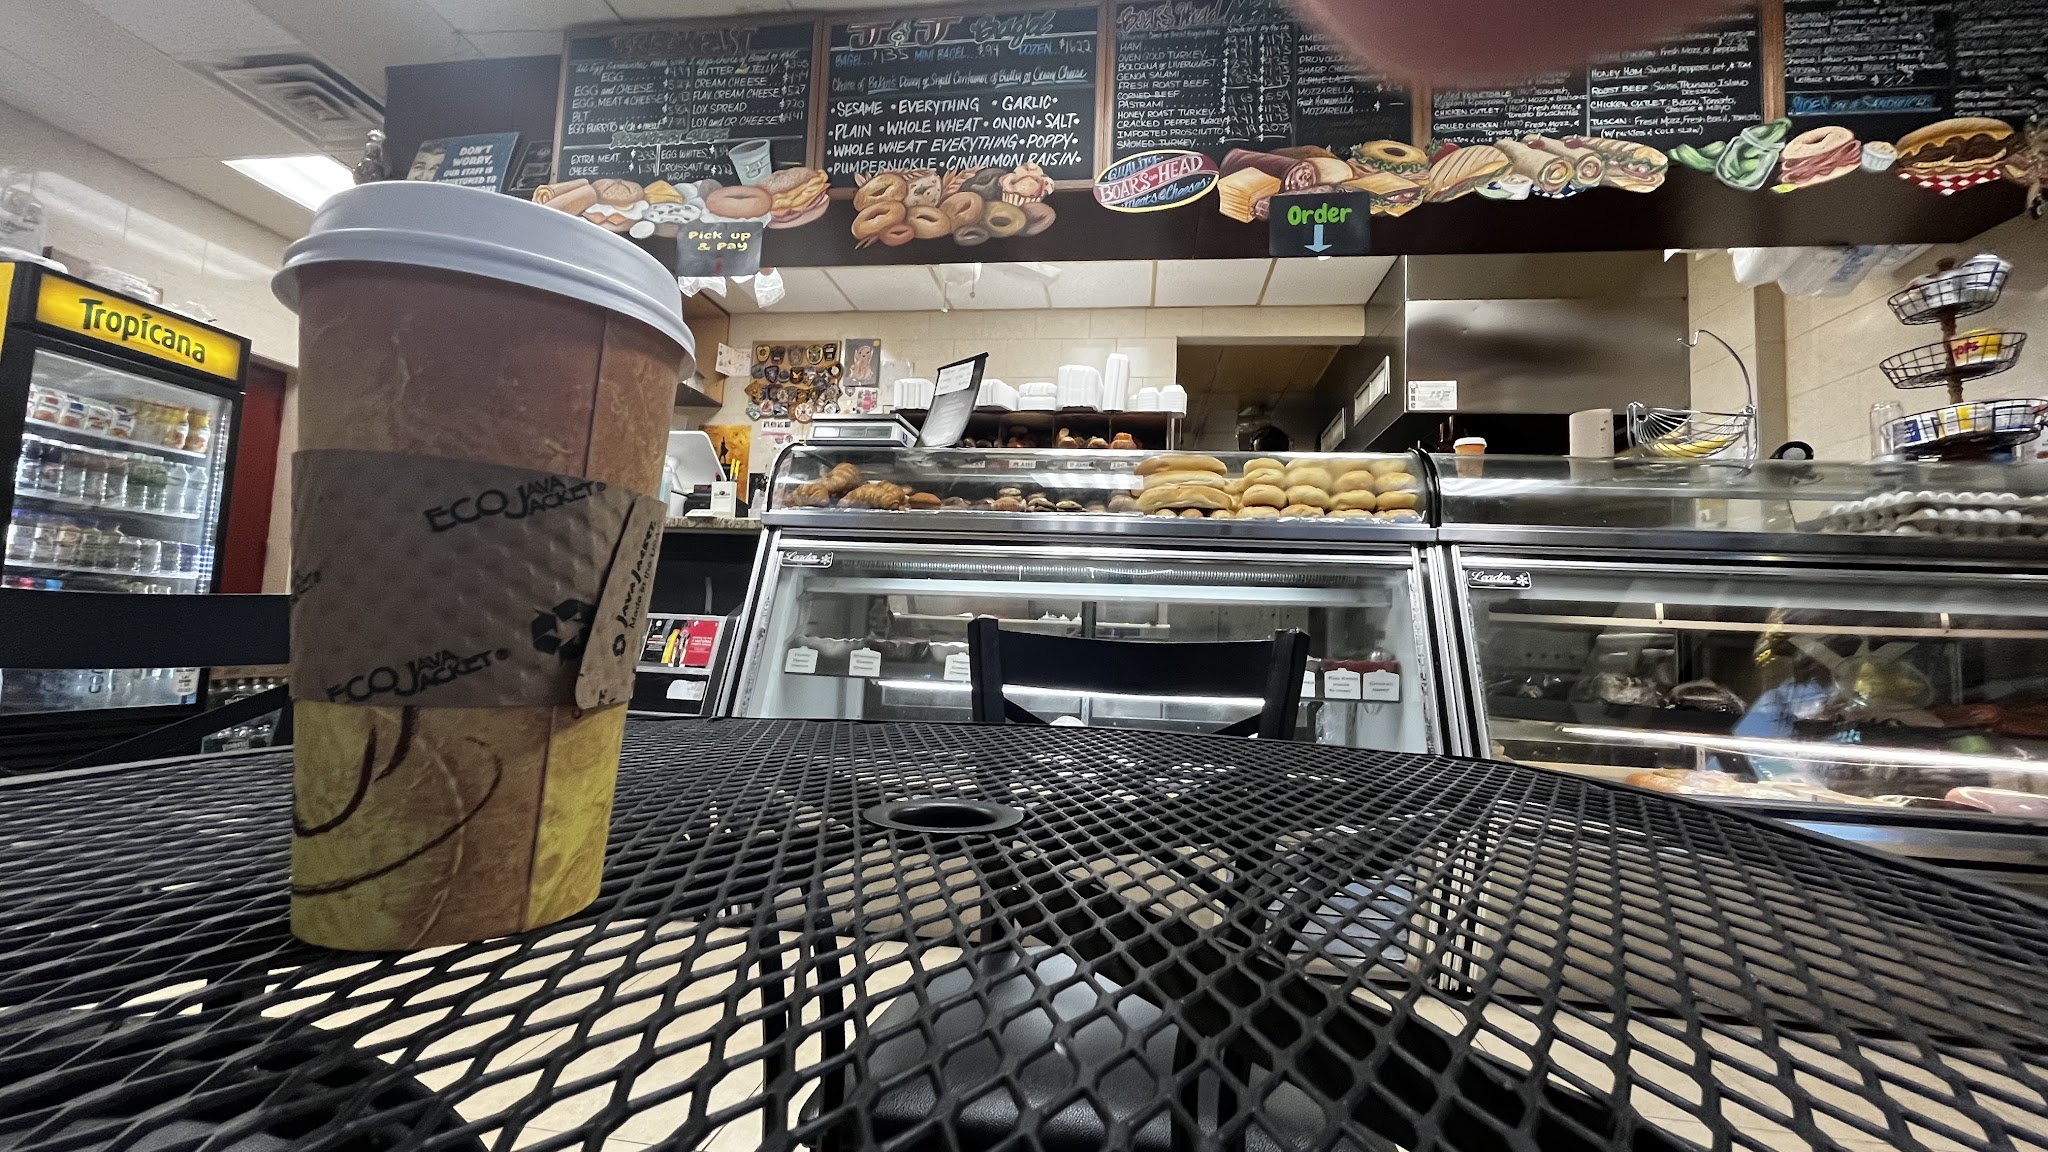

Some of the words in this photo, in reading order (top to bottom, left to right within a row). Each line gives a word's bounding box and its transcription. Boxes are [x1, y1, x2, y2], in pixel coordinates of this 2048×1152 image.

[1019, 42, 1052, 55] DOZEN
[1119, 42, 1142, 51] HAM
[1118, 53, 1140, 62] OVEN
[1167, 48, 1207, 59] TURKEY
[697, 66, 734, 76] BUTTER
[749, 63, 778, 76] JELLY
[1118, 62, 1158, 71] BOLOGNA
[1297, 66, 1327, 75] SHARP
[601, 72, 624, 82] EGG
[1116, 72, 1146, 81] GENOA
[695, 79, 726, 89] CREAM
[728, 77, 767, 86] CHEESE
[1119, 81, 1148, 89] FRESH
[1153, 80, 1181, 88] ROAST
[1183, 79, 1209, 87] BEEF
[574, 86, 598, 97] EGG
[617, 83, 654, 95] CHEESE
[693, 91, 713, 101] FLAV
[714, 89, 744, 100] CREAM
[746, 88, 780, 98] CHEESE
[1298, 86, 1354, 96] MOZZARELLA
[598, 97, 624, 107] MEAT
[630, 94, 664, 105] CHEESE
[837, 101, 883, 117] SESAME
[899, 97, 979, 115] EVERYTHING
[1002, 95, 1051, 111] GARLIC
[1591, 100, 1628, 108] CHICKEN
[692, 104, 708, 114] LOX
[710, 102, 747, 113] SPREAD
[1118, 111, 1145, 120] HONEY
[1147, 109, 1175, 117] ROAST
[1178, 108, 1215, 117] TURKEY
[1302, 106, 1354, 116] MOZZARELLA
[572, 111, 591, 123] BLT
[691, 117, 708, 128] LOX
[739, 116, 779, 126] CHEESE
[568, 123, 585, 135] EGG
[586, 122, 618, 134] BURRITO
[835, 123, 872, 141] PLAIN
[887, 120, 931, 135] WHOLE
[935, 117, 983, 132] WHEAT
[993, 115, 1035, 130] ONION
[1045, 113, 1077, 130] SALT
[1117, 120, 1160, 129] CRACKED
[1164, 118, 1197, 126] PEPPER
[1117, 130, 1167, 139] IMPORTED
[1170, 127, 1223, 136] PROSCIUTTO
[459, 144, 493, 156] DON'T
[834, 142, 874, 157] WHOLE
[879, 140, 928, 154] WHEAT
[930, 134, 1018, 153] EVERYTHING
[1026, 132, 1074, 149] POPPY
[571, 154, 595, 165] EXTRA
[598, 152, 621, 163] MEAT
[661, 150, 676, 160] EGG
[679, 148, 707, 158] WHITES
[453, 155, 493, 167] WORRY,
[833, 158, 936, 175] PUMPERNICKLE
[946, 153, 1024, 170] CINNAMON
[1028, 151, 1078, 167] RAISIN
[461, 167, 485, 176] STAFF
[569, 166, 599, 176] CHEESE
[660, 163, 704, 172] CROISSANT
[1158, 155, 1204, 184] HEAD
[667, 173, 691, 181] WRAP
[1288, 202, 1353, 225] Order
[688, 231, 723, 240] Pick
[730, 232, 752, 241] up
[697, 242, 711, 251] &
[79, 298, 206, 364] Tropicana
[423, 489, 507, 533] ECO
